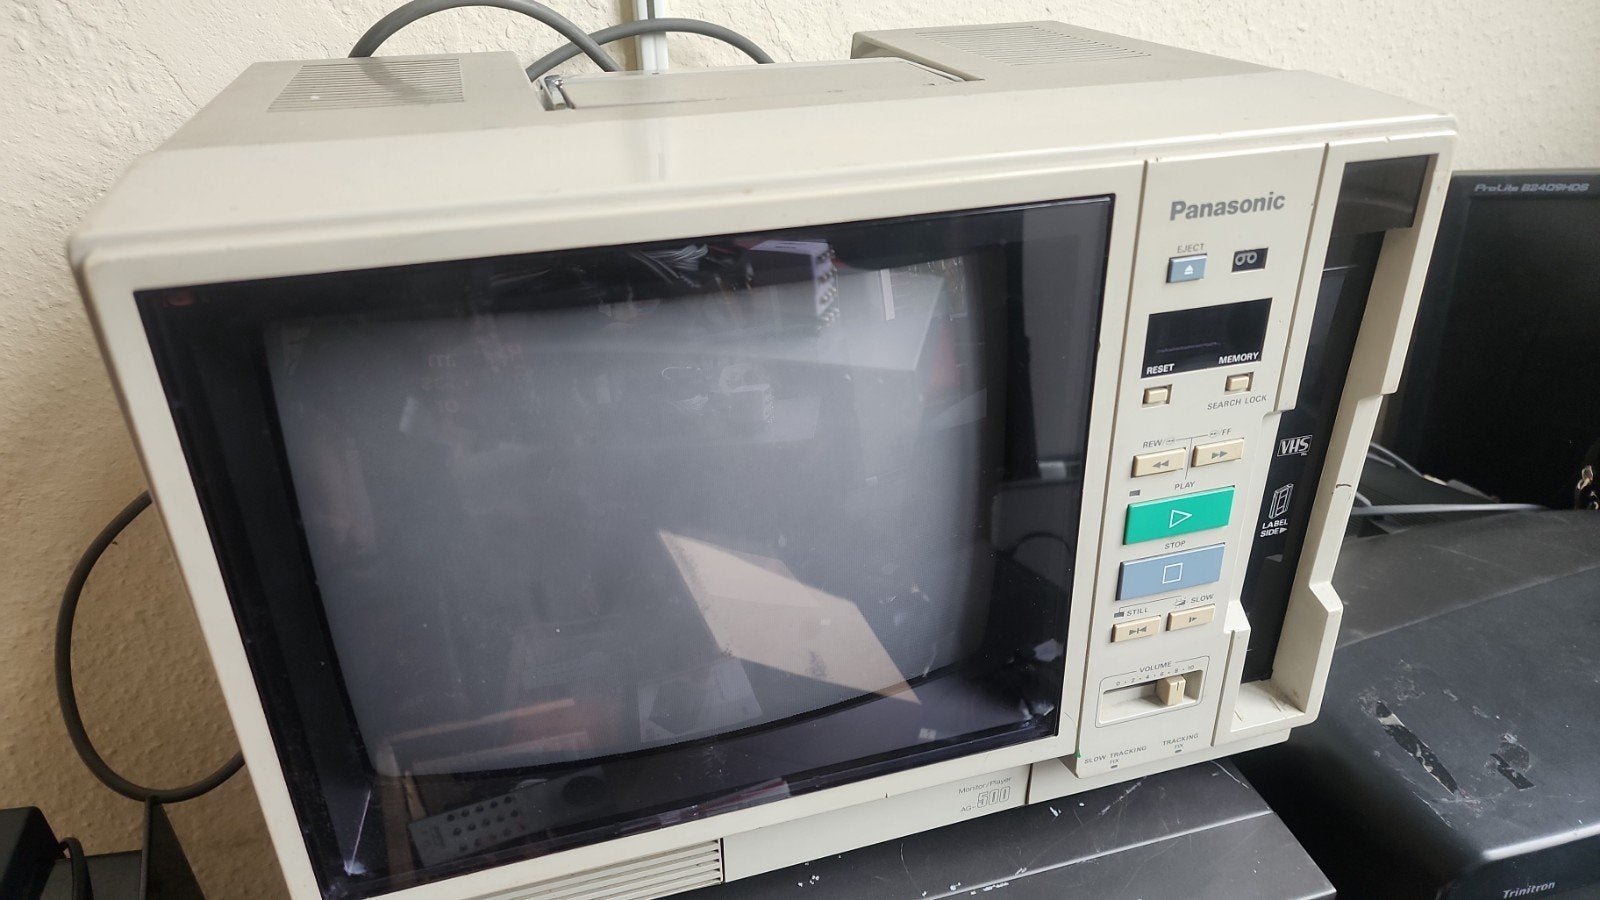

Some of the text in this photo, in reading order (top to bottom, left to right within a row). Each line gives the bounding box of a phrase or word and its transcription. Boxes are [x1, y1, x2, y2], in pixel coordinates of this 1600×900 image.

[1474, 183, 1520, 192] ProLite
[1169, 191, 1286, 221] Panasonic
[1177, 243, 1205, 254] EJECT
[1218, 351, 1260, 365] MEMORY
[1146, 363, 1176, 375] RESET
[1206, 395, 1267, 411] SEARCH LOCK
[1280, 437, 1309, 455] VHS
[1174, 480, 1196, 490] PLAY
[1262, 518, 1289, 530] LABEL
[1260, 527, 1280, 538] SIDE
[1164, 540, 1186, 550] STOP
[1190, 593, 1215, 604] SLOW
[1126, 607, 1148, 617] STILL
[1139, 661, 1172, 673] VOLUME
[1162, 733, 1200, 747] TRACKING
[1084, 745, 1148, 765] SLOW TRACKING
[958, 776, 1013, 795] Monitor/Player
[1502, 881, 1556, 899] Trinitron
